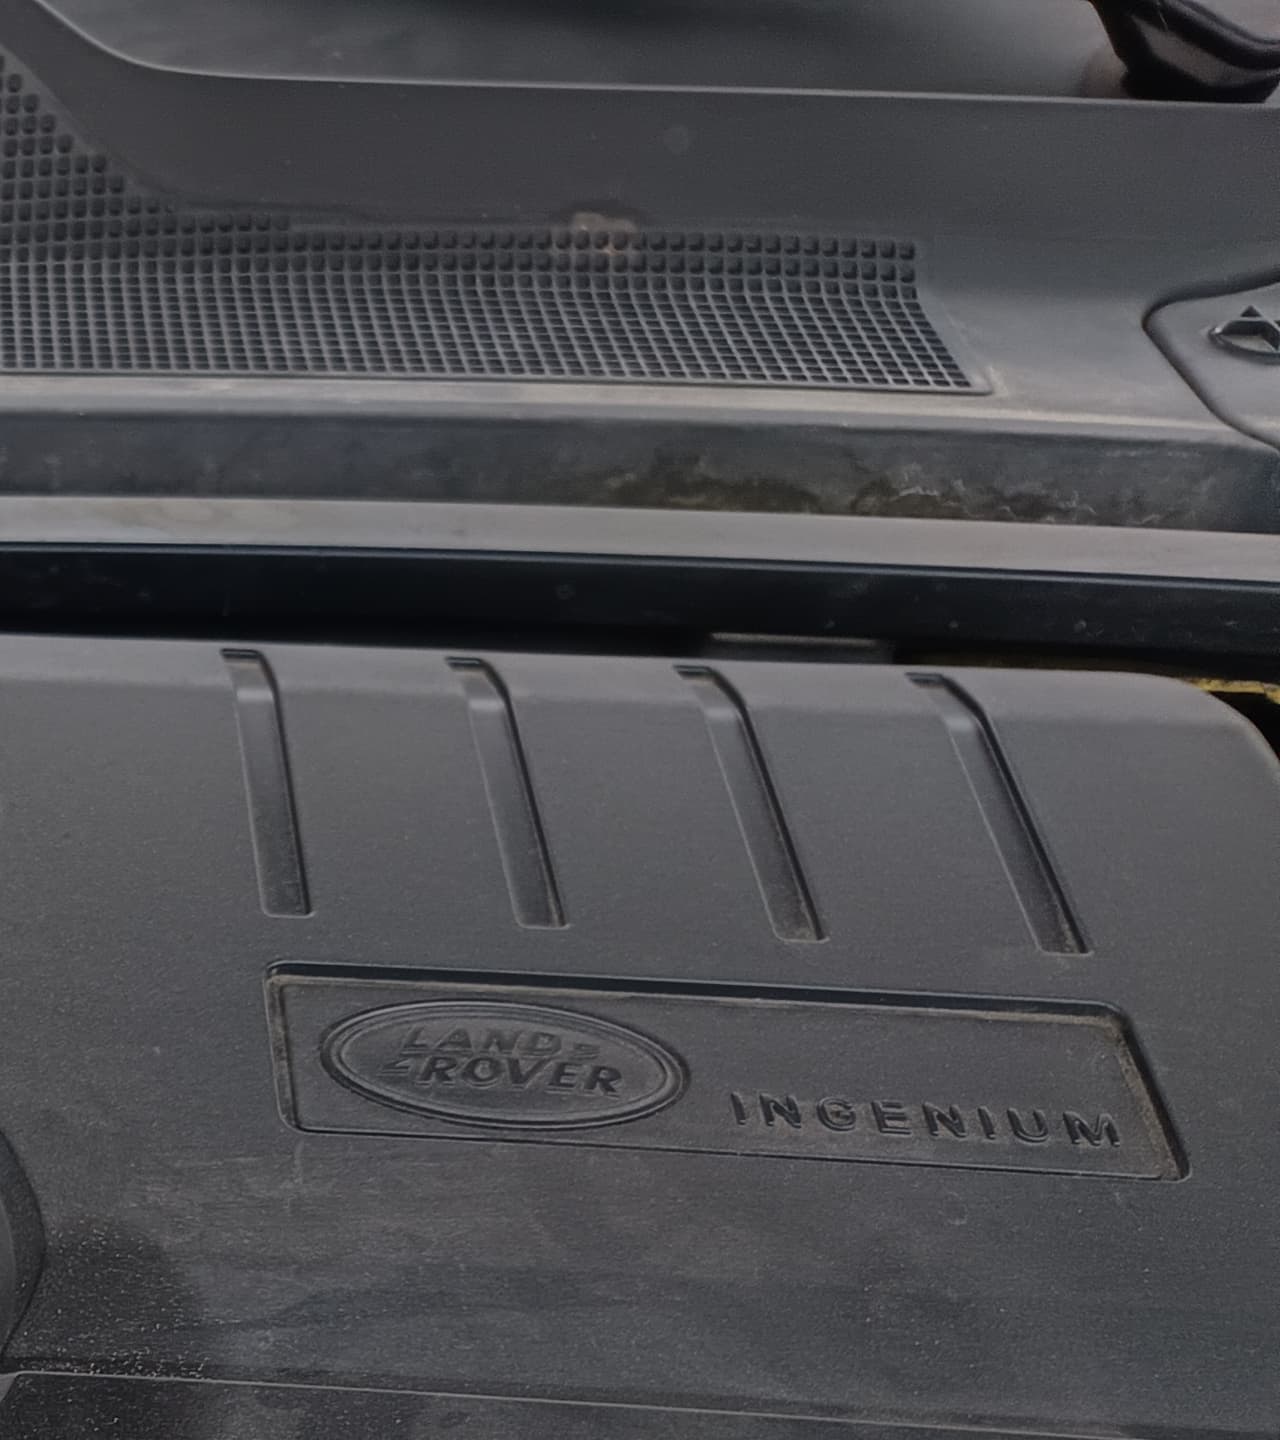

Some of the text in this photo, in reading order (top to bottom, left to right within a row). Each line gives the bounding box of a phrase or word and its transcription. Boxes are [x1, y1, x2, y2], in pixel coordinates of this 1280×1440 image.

[401, 1026, 563, 1056] LAND
[415, 1055, 624, 1095] ROVER
[730, 1091, 1122, 1148] INGENIUM
